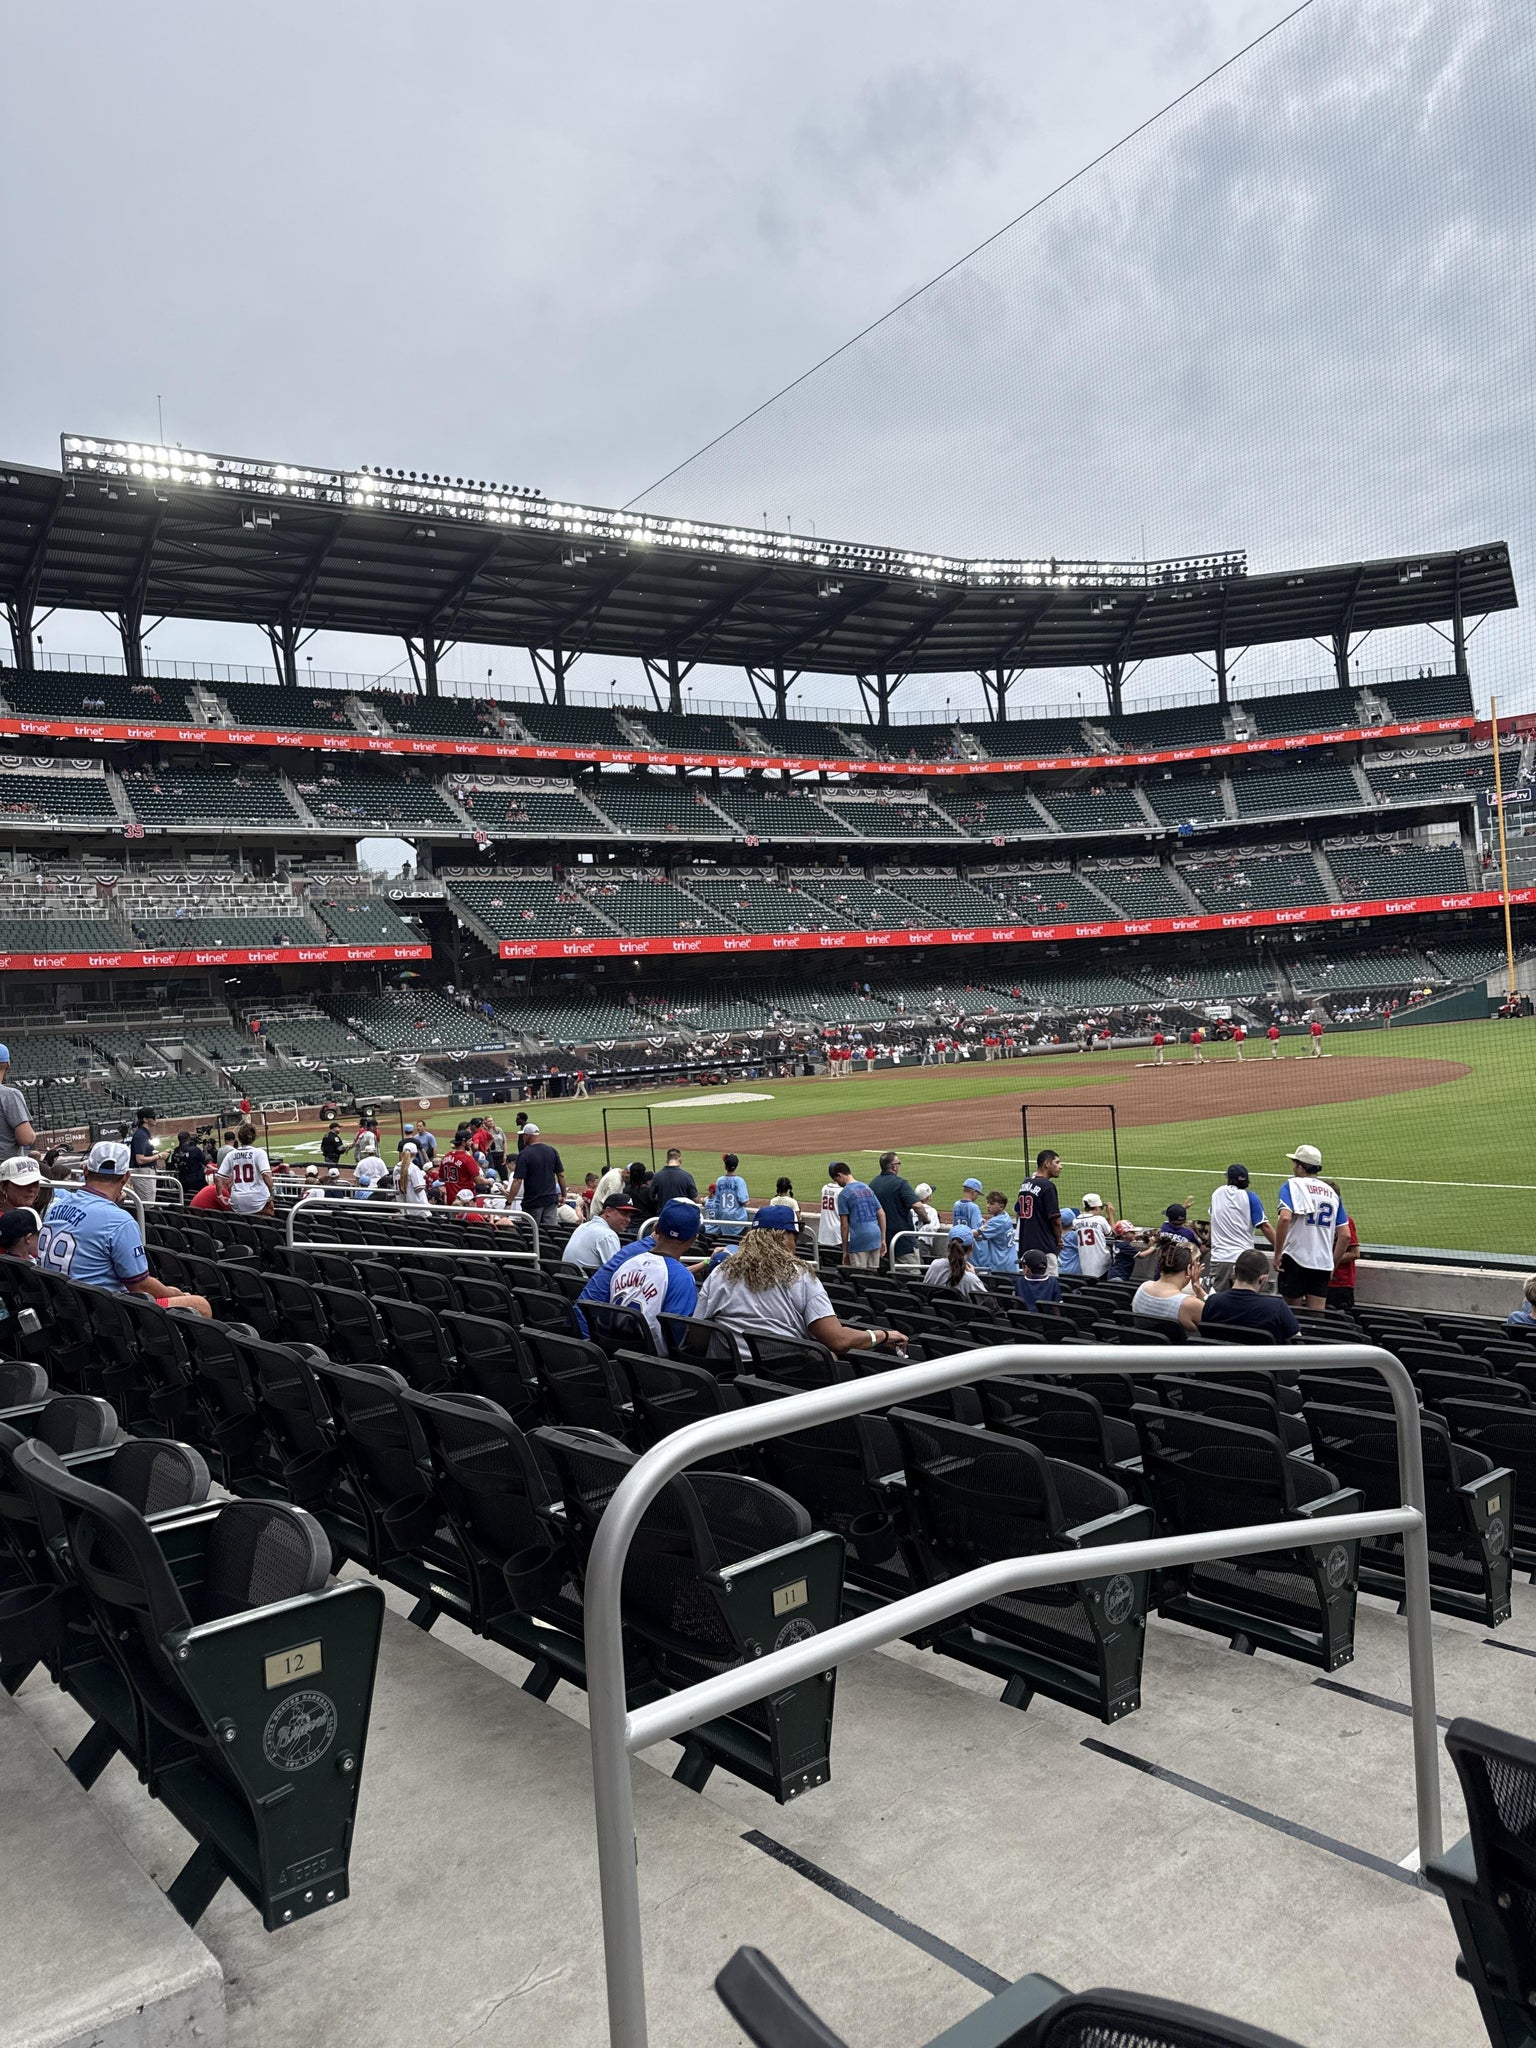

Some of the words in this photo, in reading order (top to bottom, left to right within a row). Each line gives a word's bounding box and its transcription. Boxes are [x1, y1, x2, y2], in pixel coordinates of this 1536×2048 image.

[21, 722, 51, 734] trinet
[75, 726, 105, 736] trinet
[128, 728, 157, 738] trinet
[179, 730, 207, 741] trinet
[229, 732, 256, 743] trinet
[277, 735, 304, 745] trinet
[324, 737, 350, 747] trinet
[369, 739, 394, 749] trinet
[413, 742, 438, 751] trinet
[124, 824, 145, 838] 35
[473, 831, 488, 843] 41
[745, 834, 759, 847] 44
[404, 891, 444, 899] LEXUS
[505, 944, 538, 956] trinet
[564, 942, 595, 954] trinet
[620, 941, 650, 953] trinet
[673, 939, 702, 951] trinet
[724, 938, 752, 949] trinet
[773, 937, 800, 948] trinet
[820, 935, 846, 946] trinet
[866, 934, 891, 945] trinet
[909, 933, 934, 943] trinet
[1076, 925, 1104, 936] trinet
[1125, 922, 1152, 934] trinet
[1173, 919, 1201, 930] trinet
[1223, 914, 1253, 926] trinet
[1277, 910, 1307, 922] trinet
[1331, 905, 1362, 917] trinet
[1386, 901, 1417, 913] trinet
[1442, 896, 1473, 908] trinet
[1499, 891, 1531, 903] tinet
[34, 956, 67, 967] trinet
[89, 955, 122, 966] trinet
[143, 954, 176, 965] trinet
[197, 952, 228, 963] trinet
[249, 951, 279, 962] trinet
[299, 950, 329, 960] trinet
[348, 949, 377, 959] trinet
[395, 948, 423, 958] trinet
[72, 1133, 86, 1141] PARK
[233, 1152, 253, 1160] JONES
[233, 1163, 255, 1183] 10
[443, 1165, 458, 1184] 13
[721, 1192, 735, 1208] 13
[822, 1195, 835, 1211] 28
[1018, 1195, 1034, 1219] 13
[50, 1204, 87, 1227] STRIDER
[1077, 1228, 1095, 1246] 13
[38, 1224, 77, 1275] 99
[615, 1269, 647, 1294] ACUÑA
[784, 1589, 796, 1606] 11
[284, 1654, 305, 1675] 12
